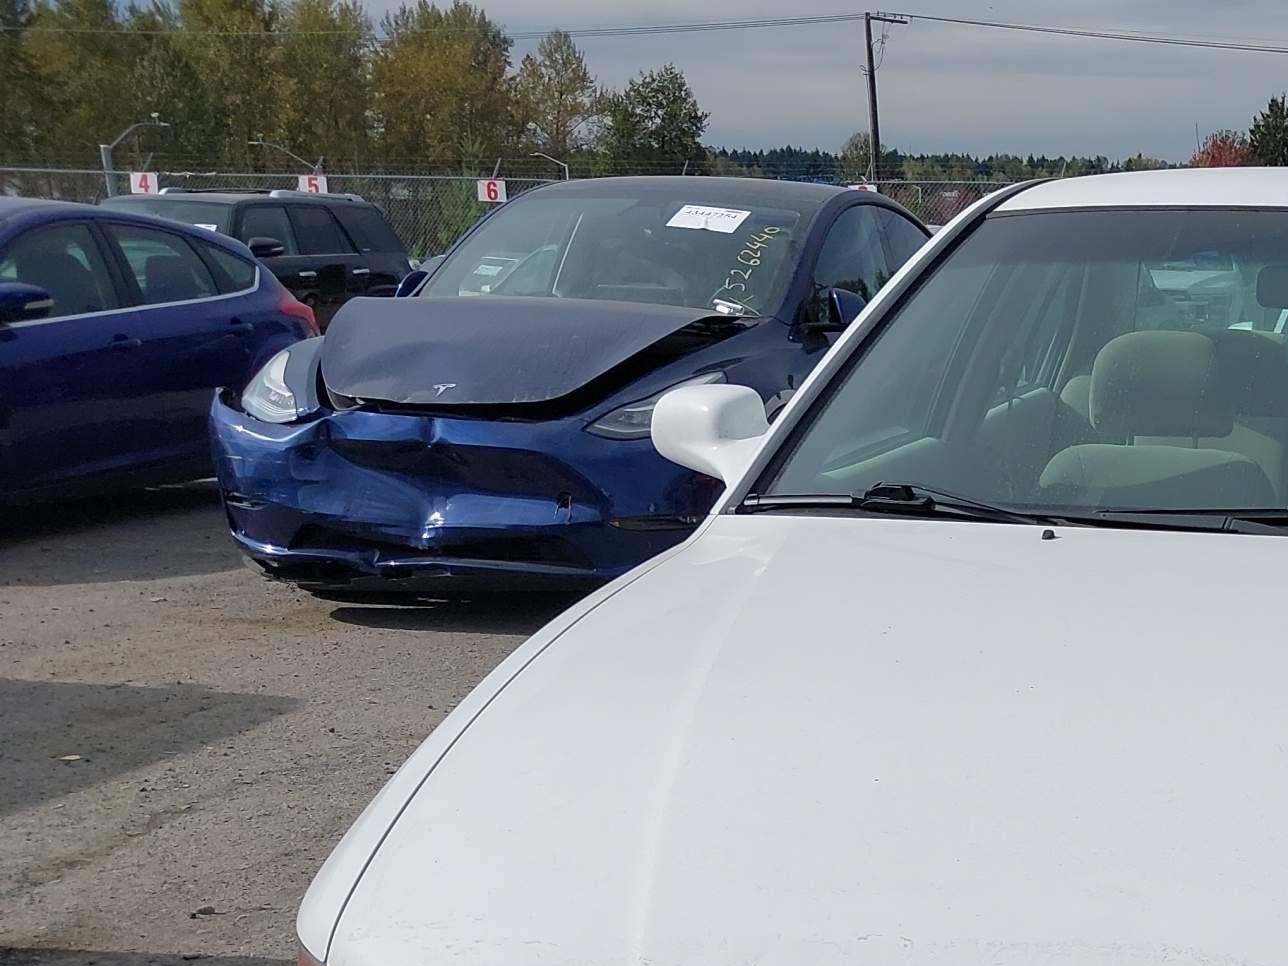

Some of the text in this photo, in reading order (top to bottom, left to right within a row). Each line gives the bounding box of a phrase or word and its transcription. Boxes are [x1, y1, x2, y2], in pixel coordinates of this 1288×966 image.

[138, 174, 149, 193] 4
[307, 176, 320, 193] 5
[486, 181, 498, 201] 6
